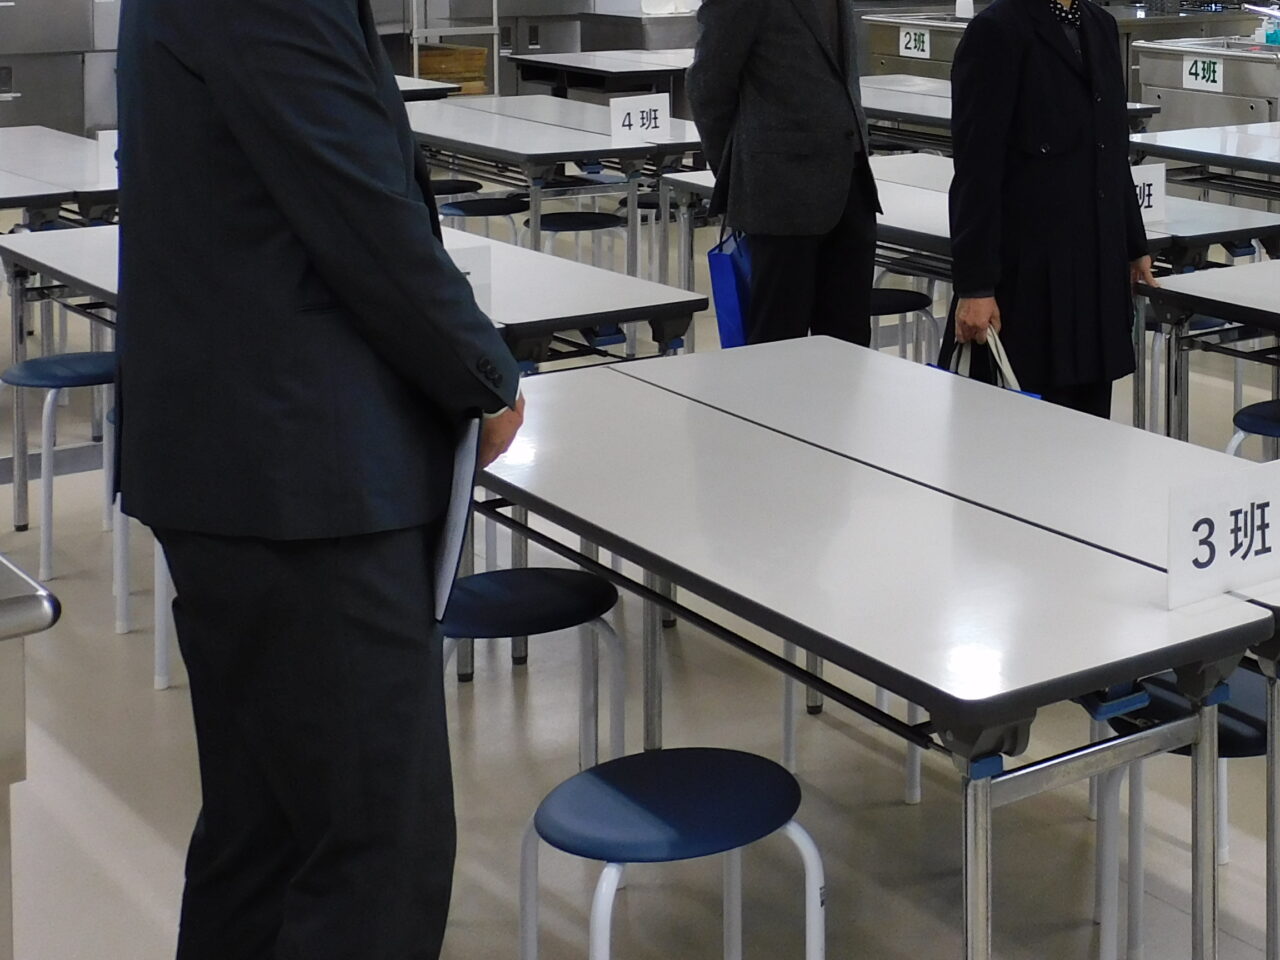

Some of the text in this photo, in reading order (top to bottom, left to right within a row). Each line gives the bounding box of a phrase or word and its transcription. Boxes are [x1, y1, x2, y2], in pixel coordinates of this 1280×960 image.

[904, 31, 925, 52] 2班
[1188, 59, 1217, 83] 4班
[621, 108, 660, 131] 4班
[1191, 501, 1272, 569] 3班
